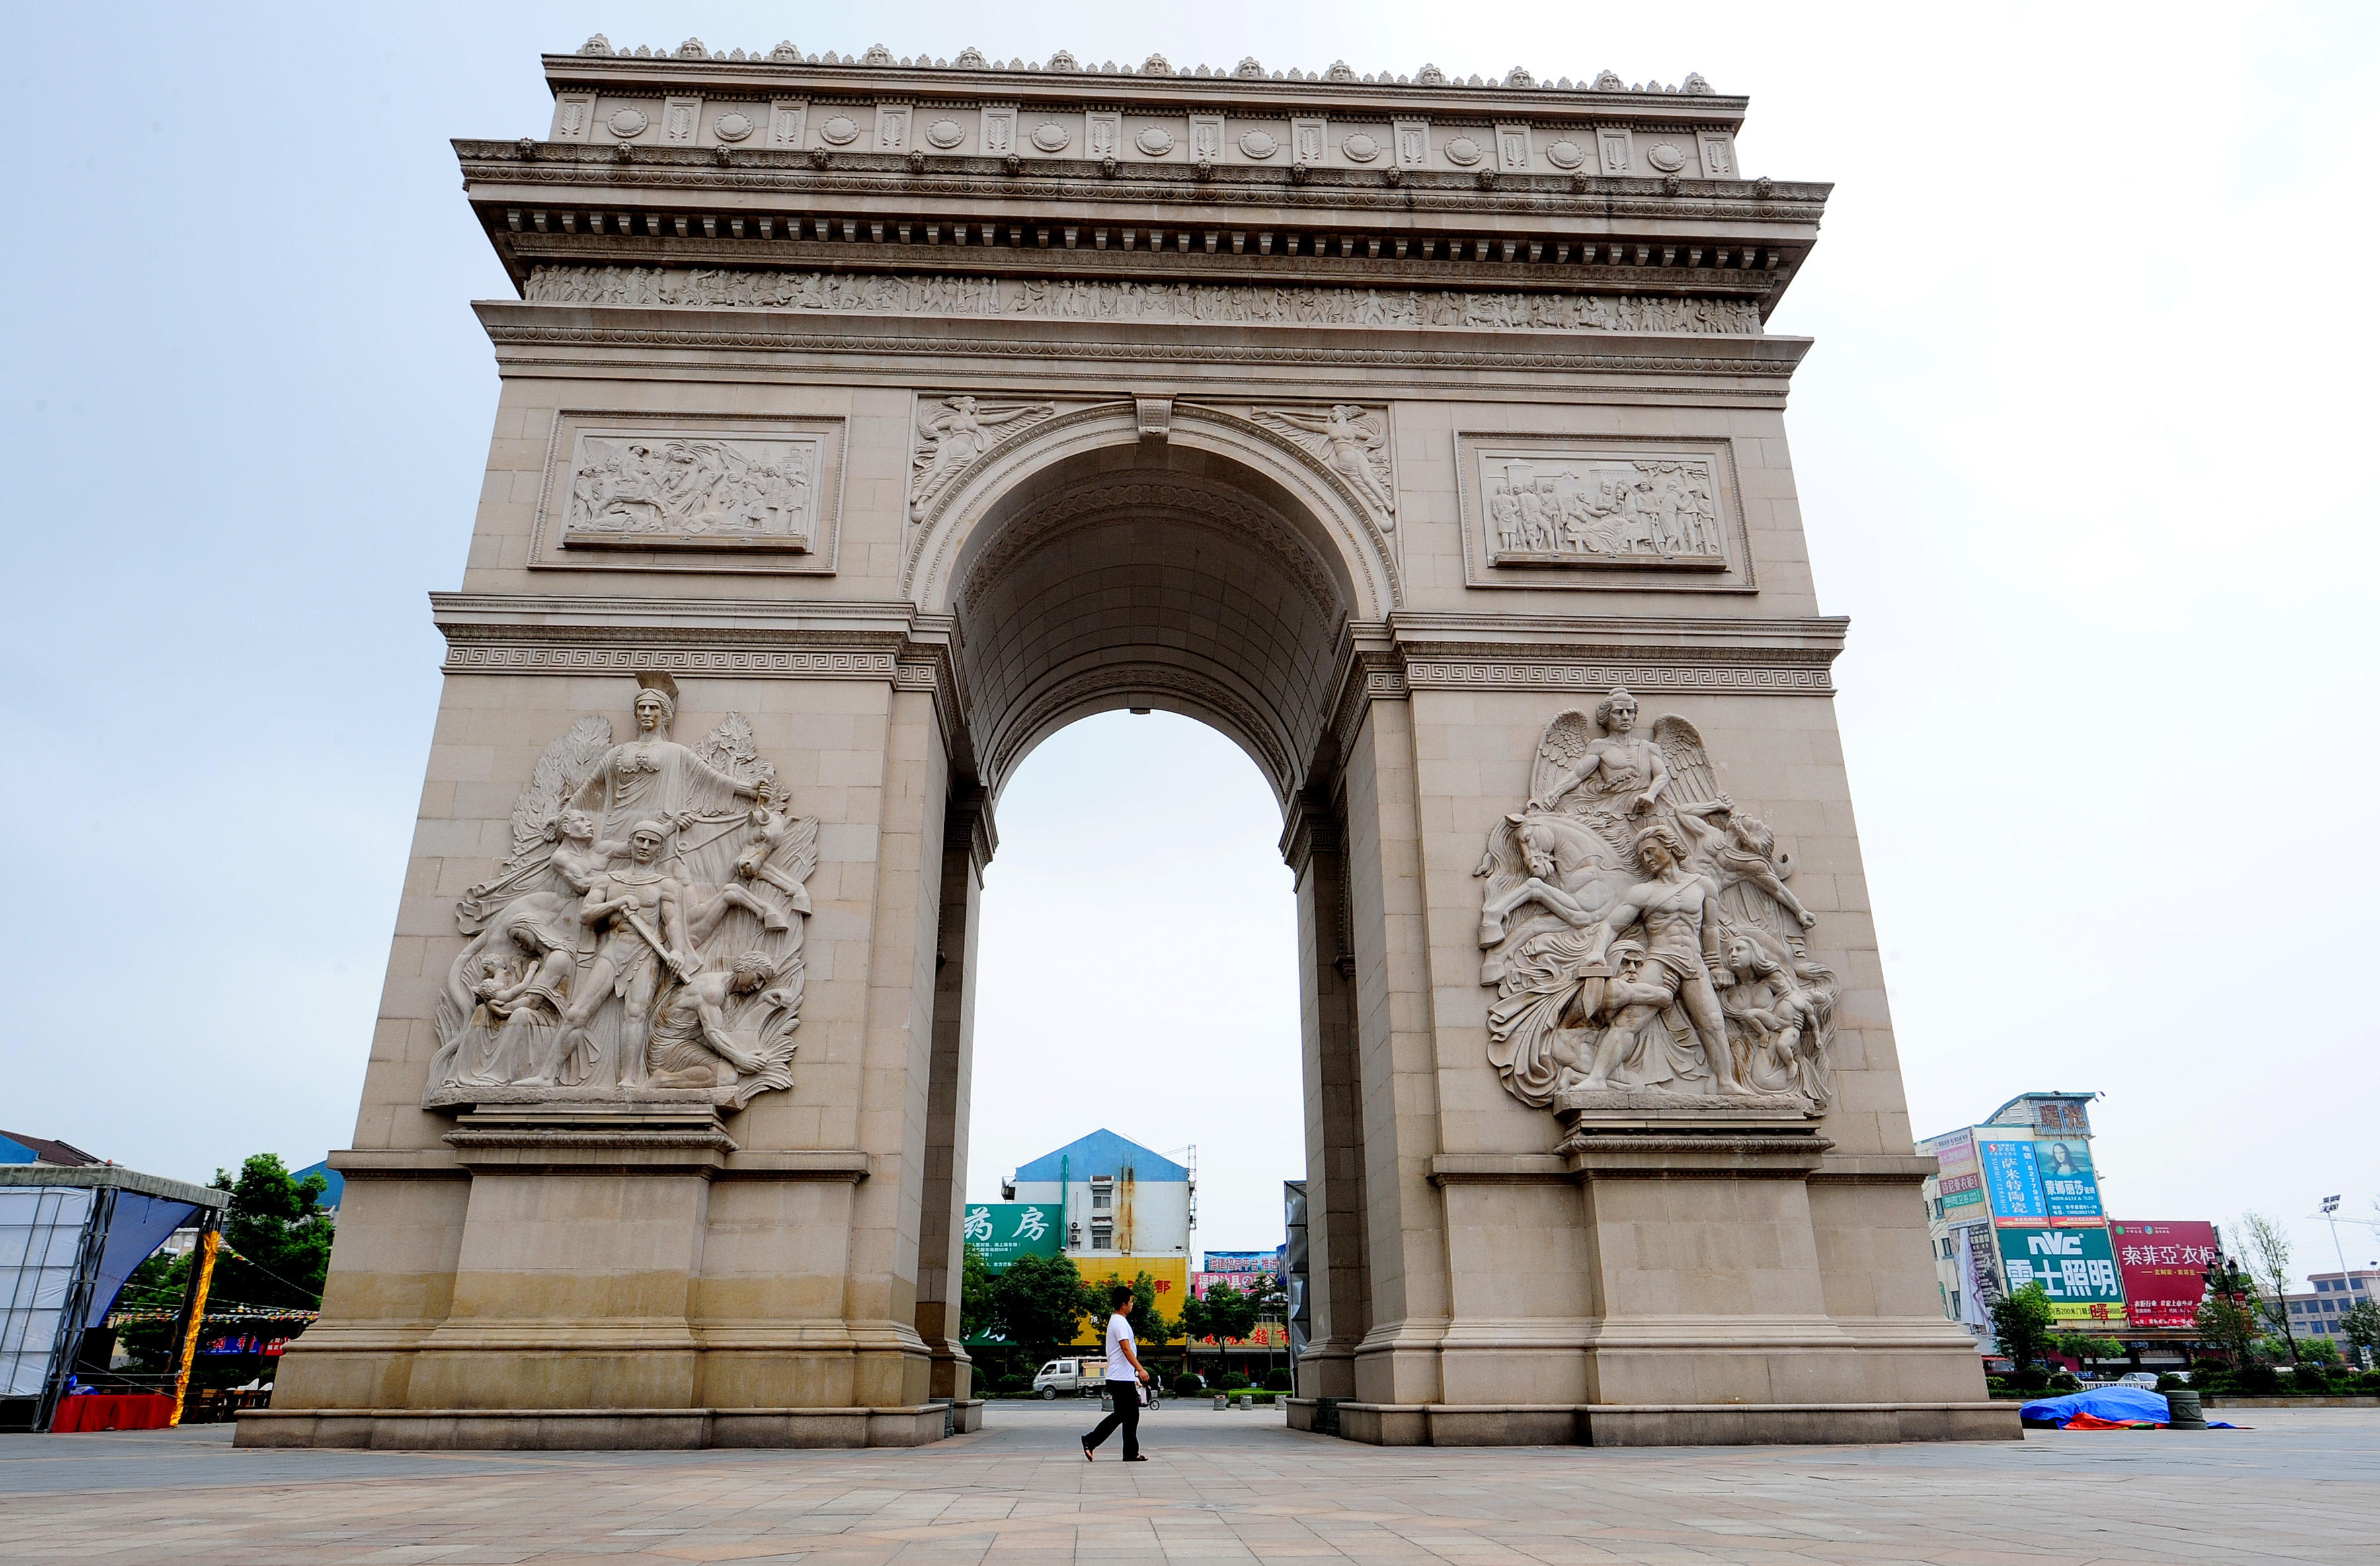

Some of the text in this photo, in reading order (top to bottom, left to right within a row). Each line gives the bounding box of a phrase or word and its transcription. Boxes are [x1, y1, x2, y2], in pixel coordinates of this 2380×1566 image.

[2039, 1102, 2086, 1129] 曙光
[2002, 1158, 2028, 1213] 萨米特陶瓷
[1209, 1258, 1258, 1270] 搭建招商平台
[2006, 1259, 2118, 1296] 雷士照明
